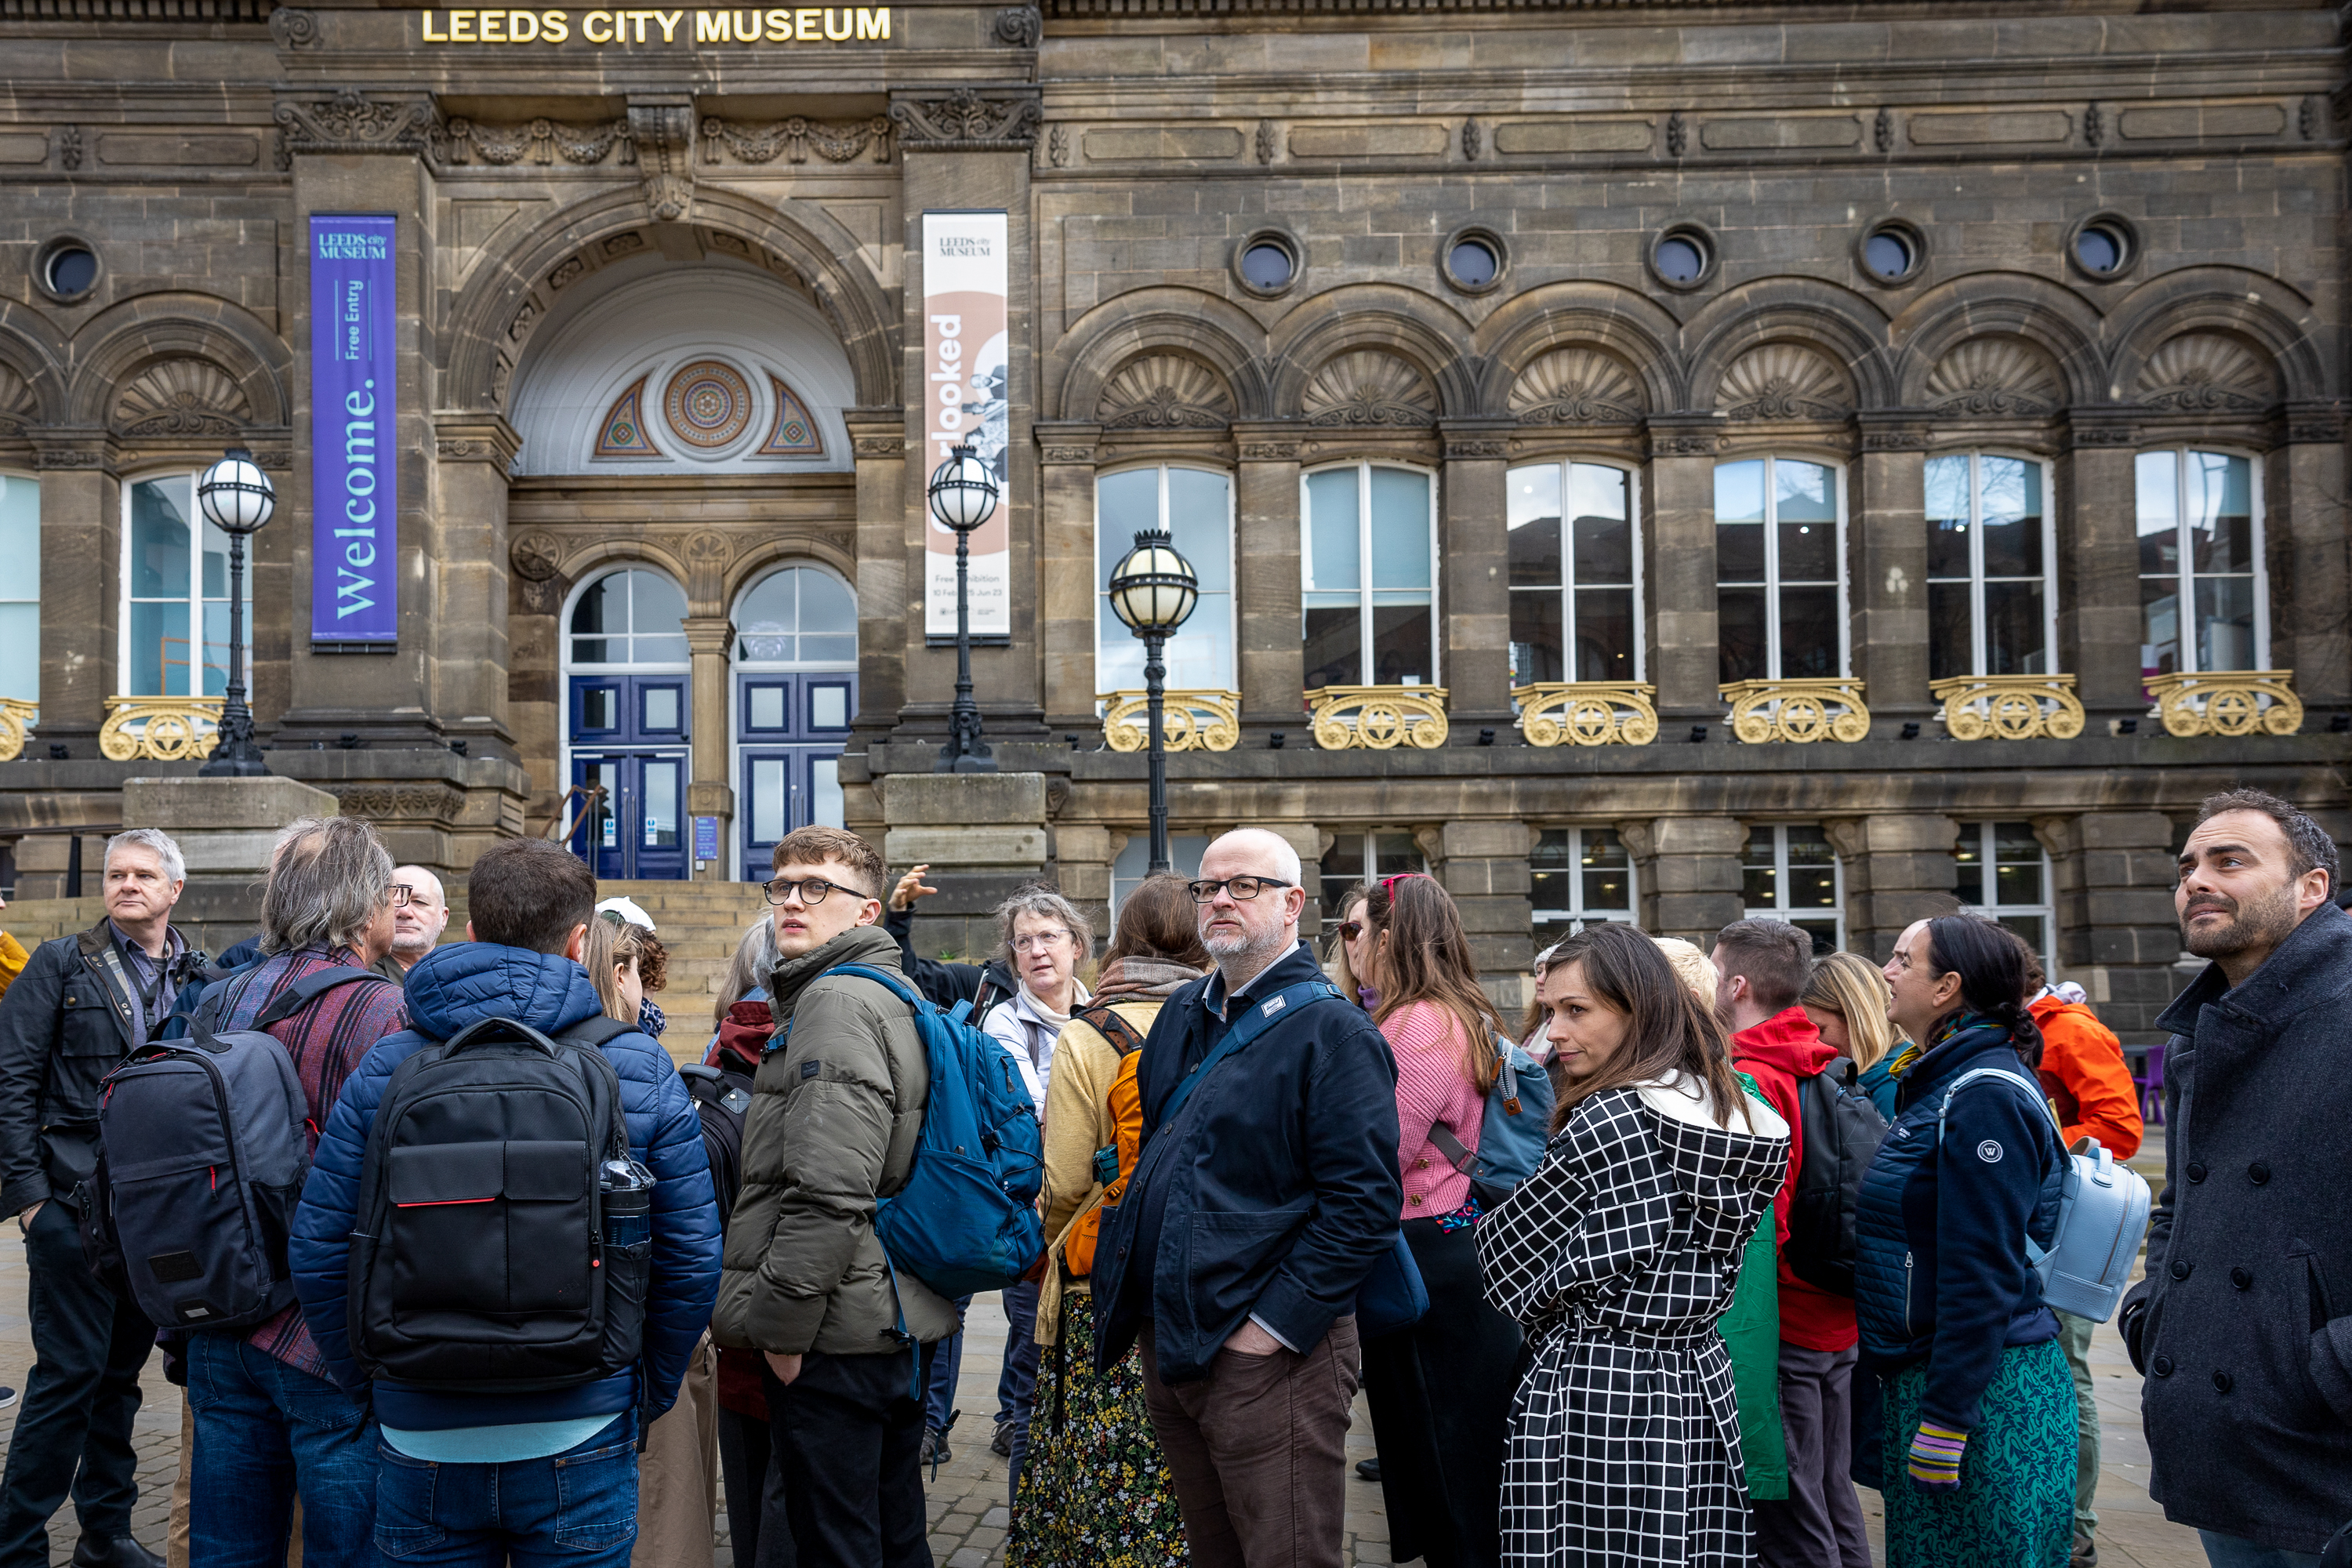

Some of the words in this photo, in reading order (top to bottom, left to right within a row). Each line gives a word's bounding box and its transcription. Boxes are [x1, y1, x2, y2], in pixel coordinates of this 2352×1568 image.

[422, 9, 569, 43] LEEDS
[582, 9, 684, 43] CITY
[695, 7, 891, 42] MUSEUM
[318, 233, 366, 247] LEEDS
[367, 234, 387, 247] city
[939, 237, 975, 246] LEEDS
[319, 246, 387, 260] MUSEUM
[940, 247, 990, 256] MUSEUM
[344, 280, 364, 322] Entry
[345, 326, 360, 361] Free
[930, 314, 963, 534] rlooked
[333, 378, 376, 619] Welcome.
[935, 574, 954, 583] Free
[1984, 1147, 1996, 1156] W
